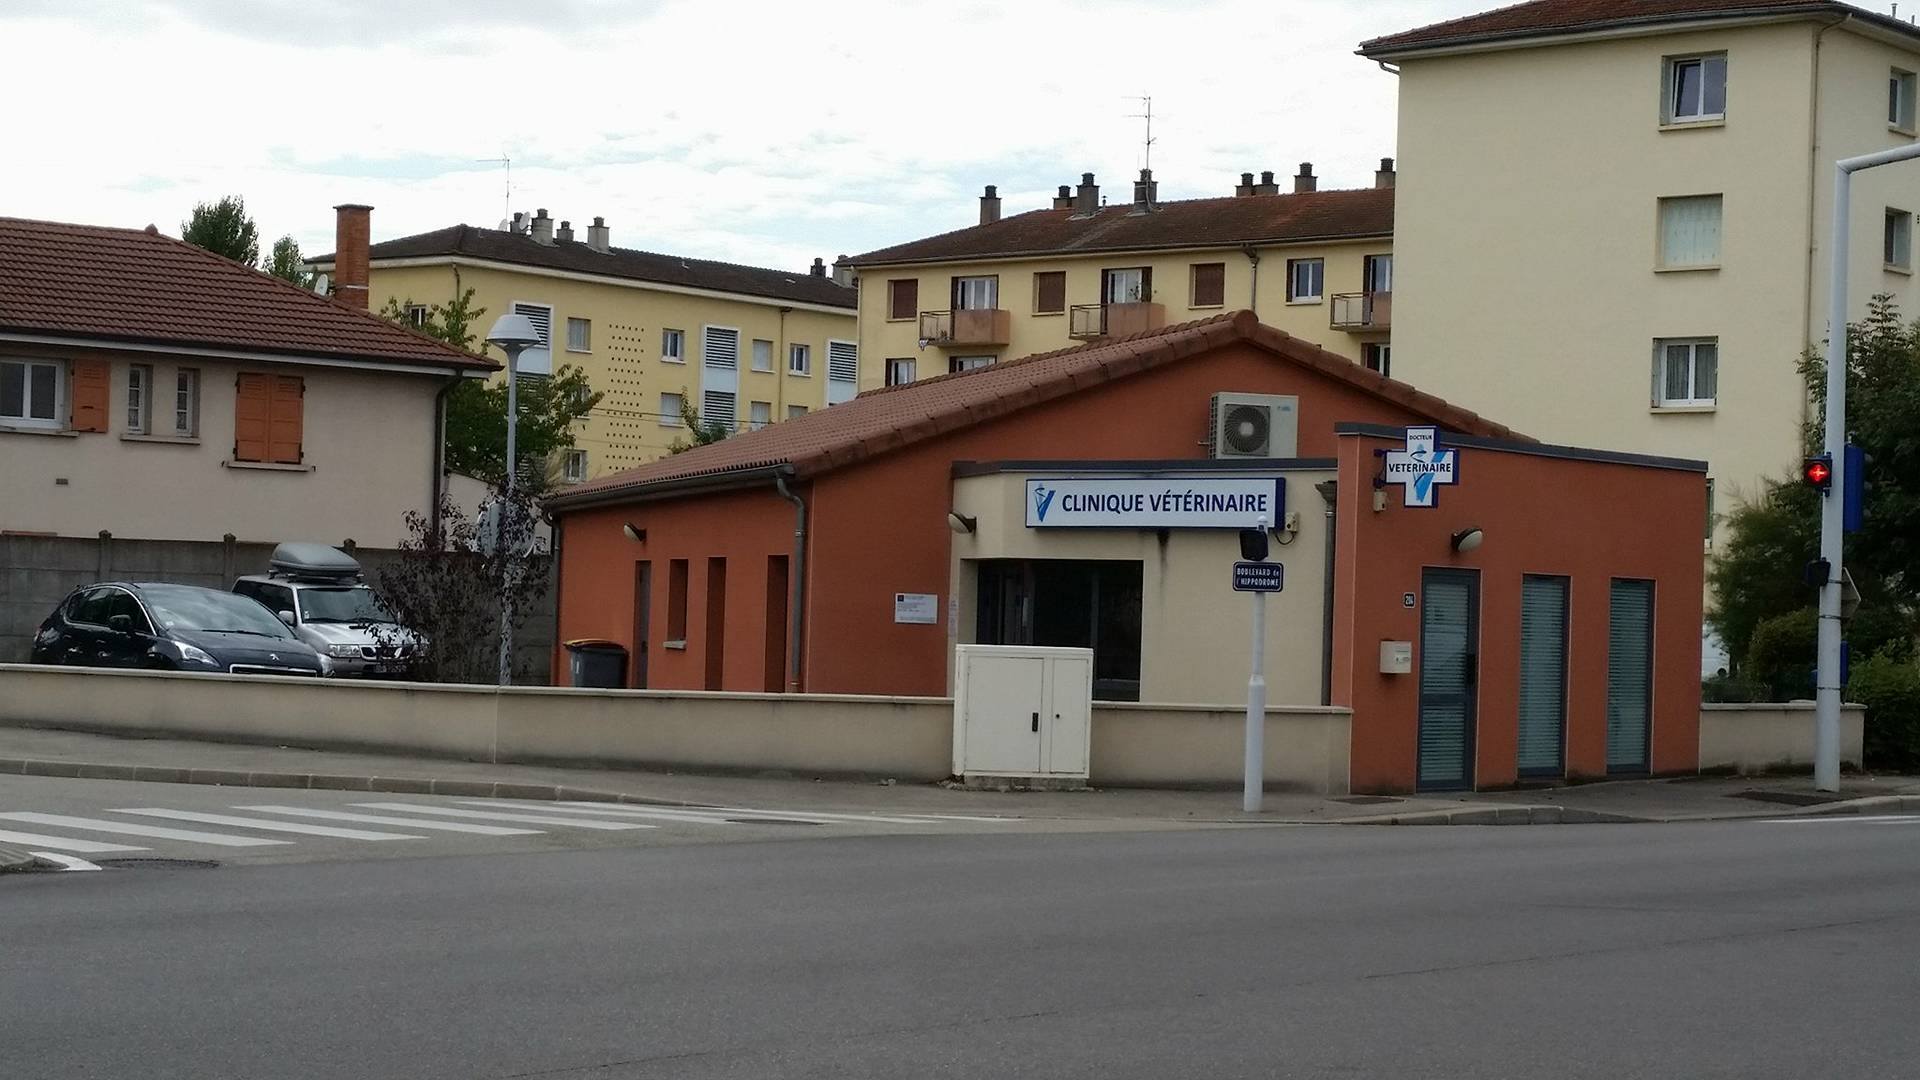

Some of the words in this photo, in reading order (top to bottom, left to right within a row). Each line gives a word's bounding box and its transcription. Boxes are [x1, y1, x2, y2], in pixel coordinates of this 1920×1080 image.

[1389, 463, 1451, 472] VETERINAIRE
[1062, 494, 1144, 514] CLINIQUE
[1150, 489, 1267, 512] VÉTÉRINAIRE
[1237, 567, 1270, 576] BOULEVARD
